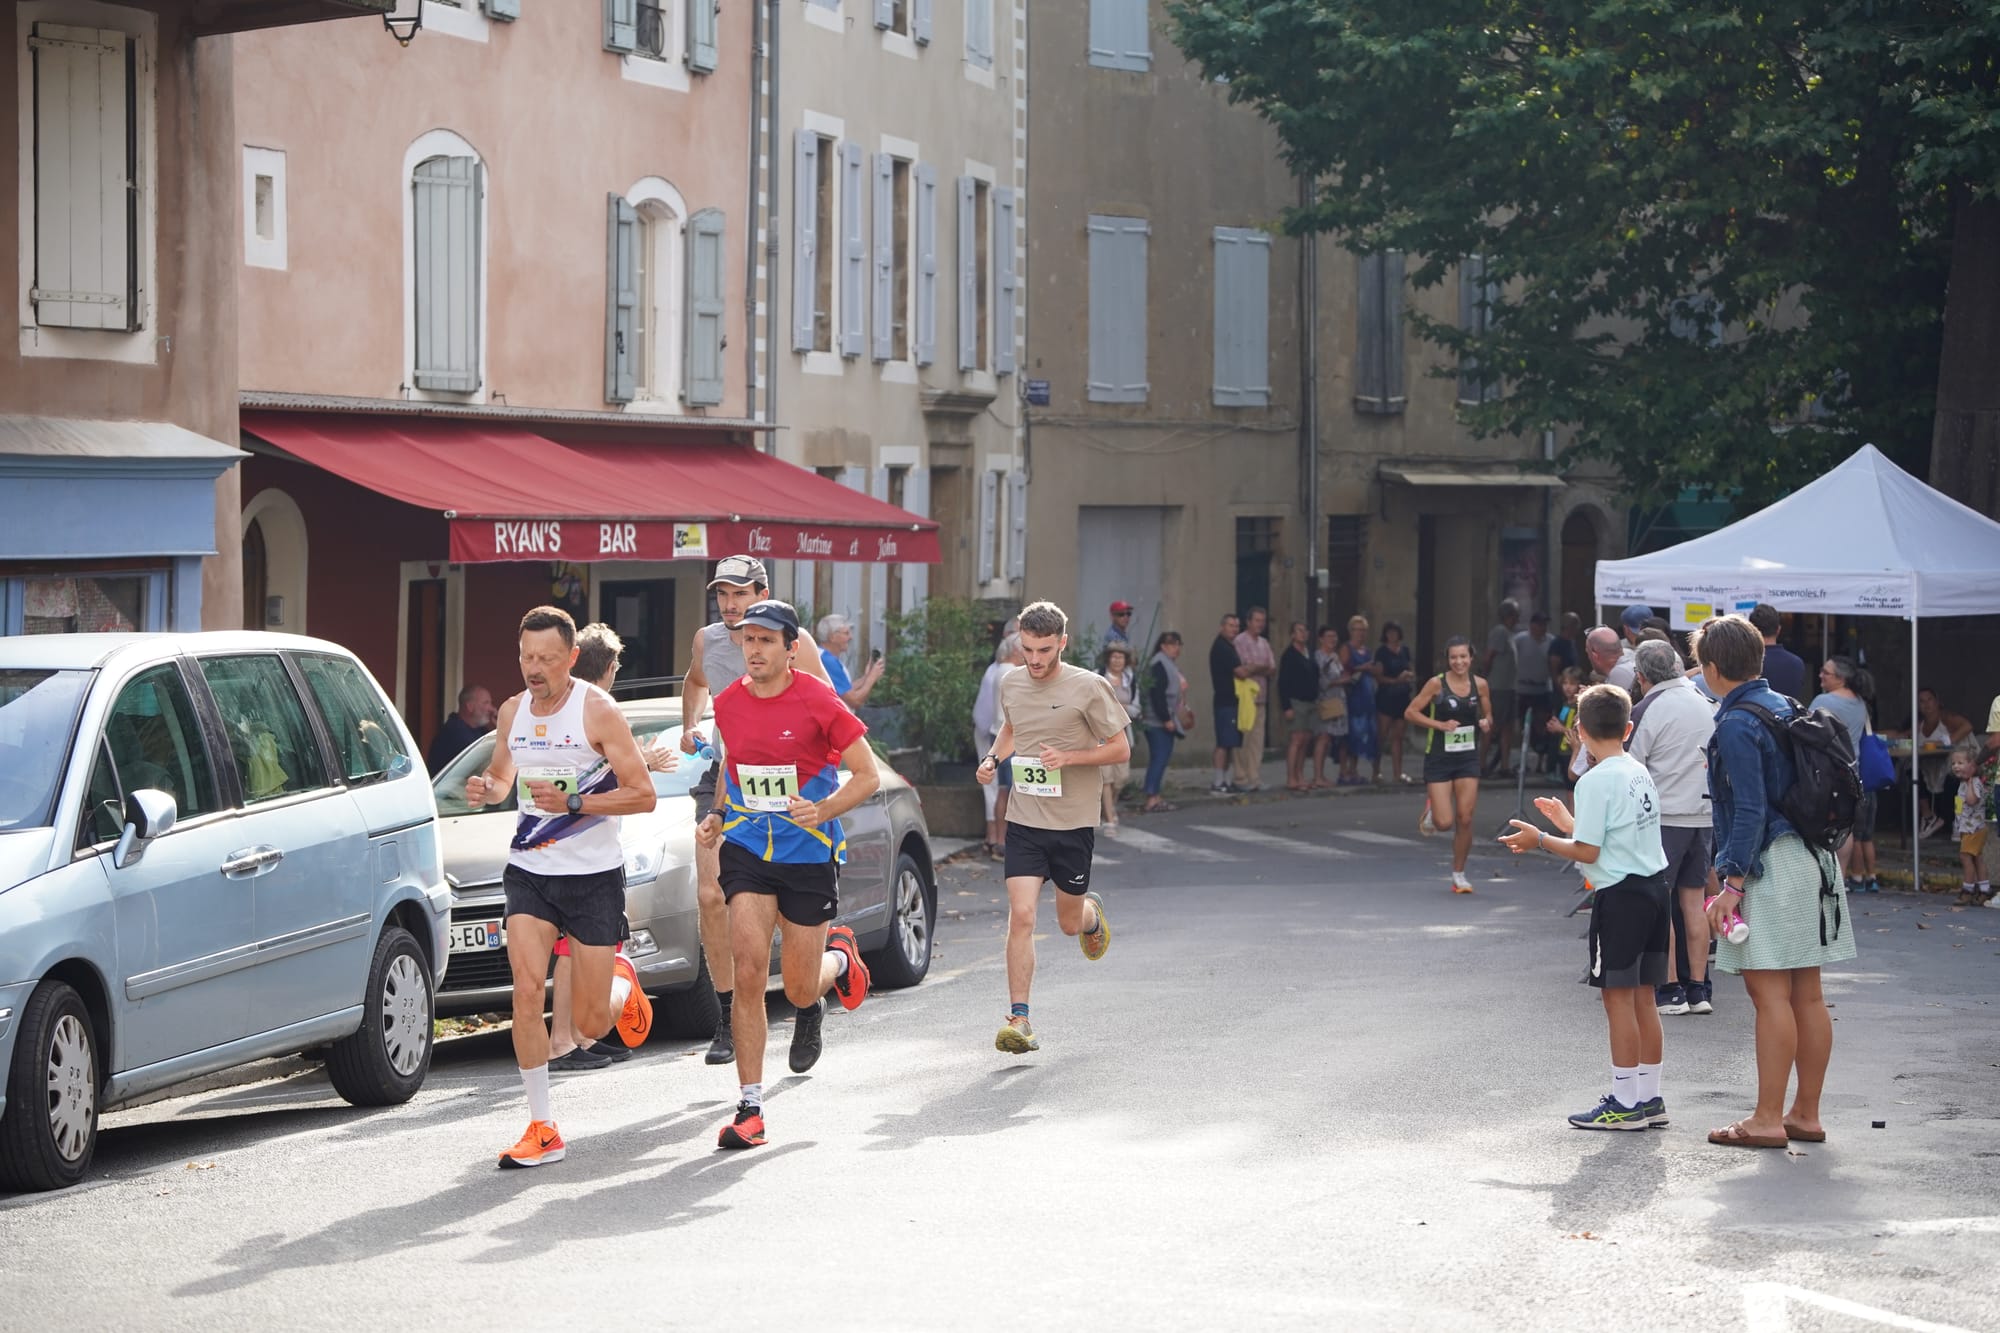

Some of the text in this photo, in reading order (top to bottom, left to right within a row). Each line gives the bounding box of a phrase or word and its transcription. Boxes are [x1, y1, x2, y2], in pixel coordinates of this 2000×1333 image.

[494, 521, 637, 553] RYAN'S BAR
[748, 526, 897, 560] Chez Martine et John
[1454, 733, 1467, 743] 21
[1023, 767, 1047, 784] 33
[746, 777, 786, 796] 111
